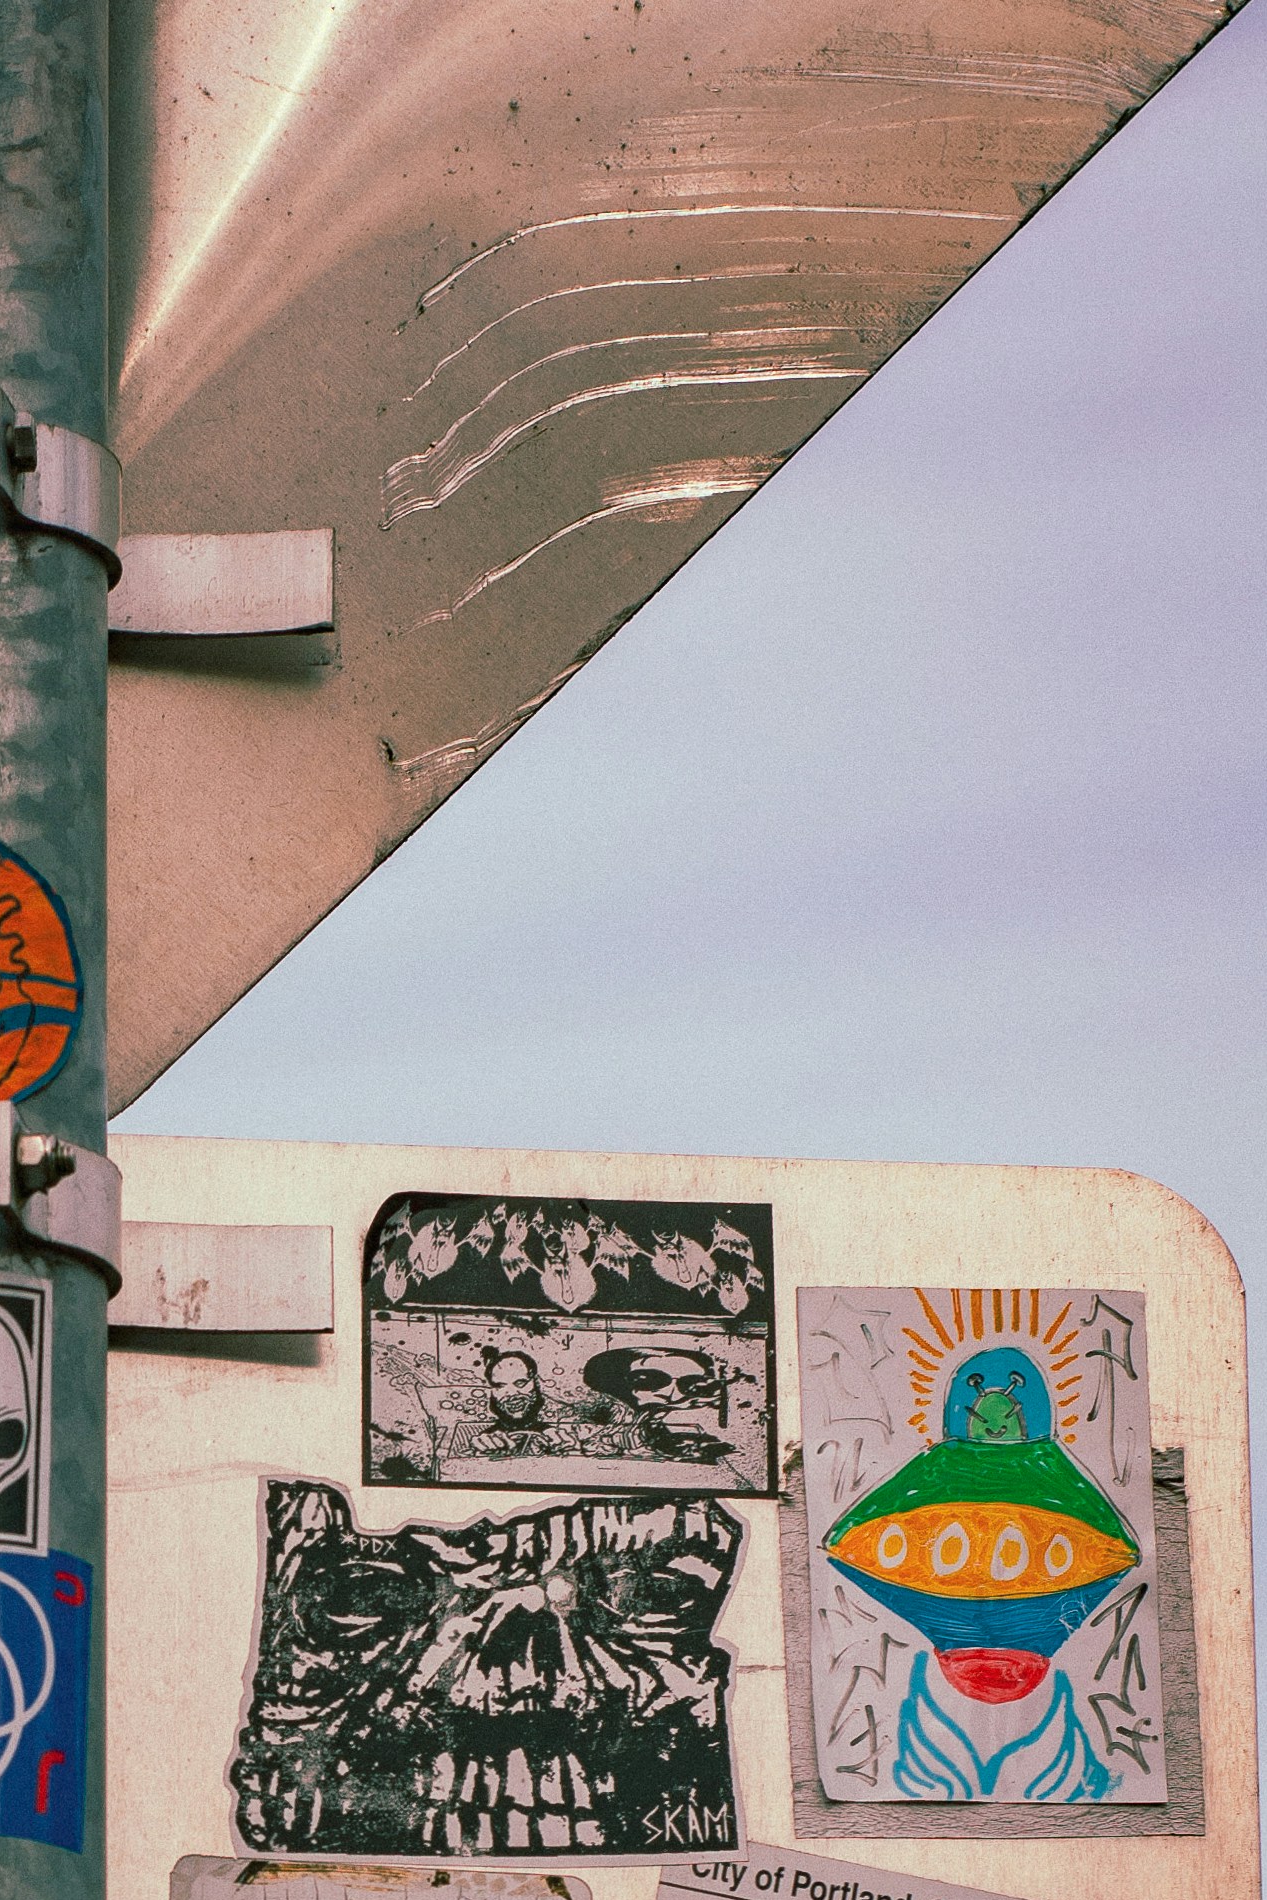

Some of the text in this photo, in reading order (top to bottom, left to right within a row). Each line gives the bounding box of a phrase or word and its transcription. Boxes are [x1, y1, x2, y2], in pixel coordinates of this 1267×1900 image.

[360, 1537, 397, 1555] PDX
[642, 1802, 729, 1844] SKAM
[692, 1862, 747, 1891] City
[755, 1867, 785, 1893] of
